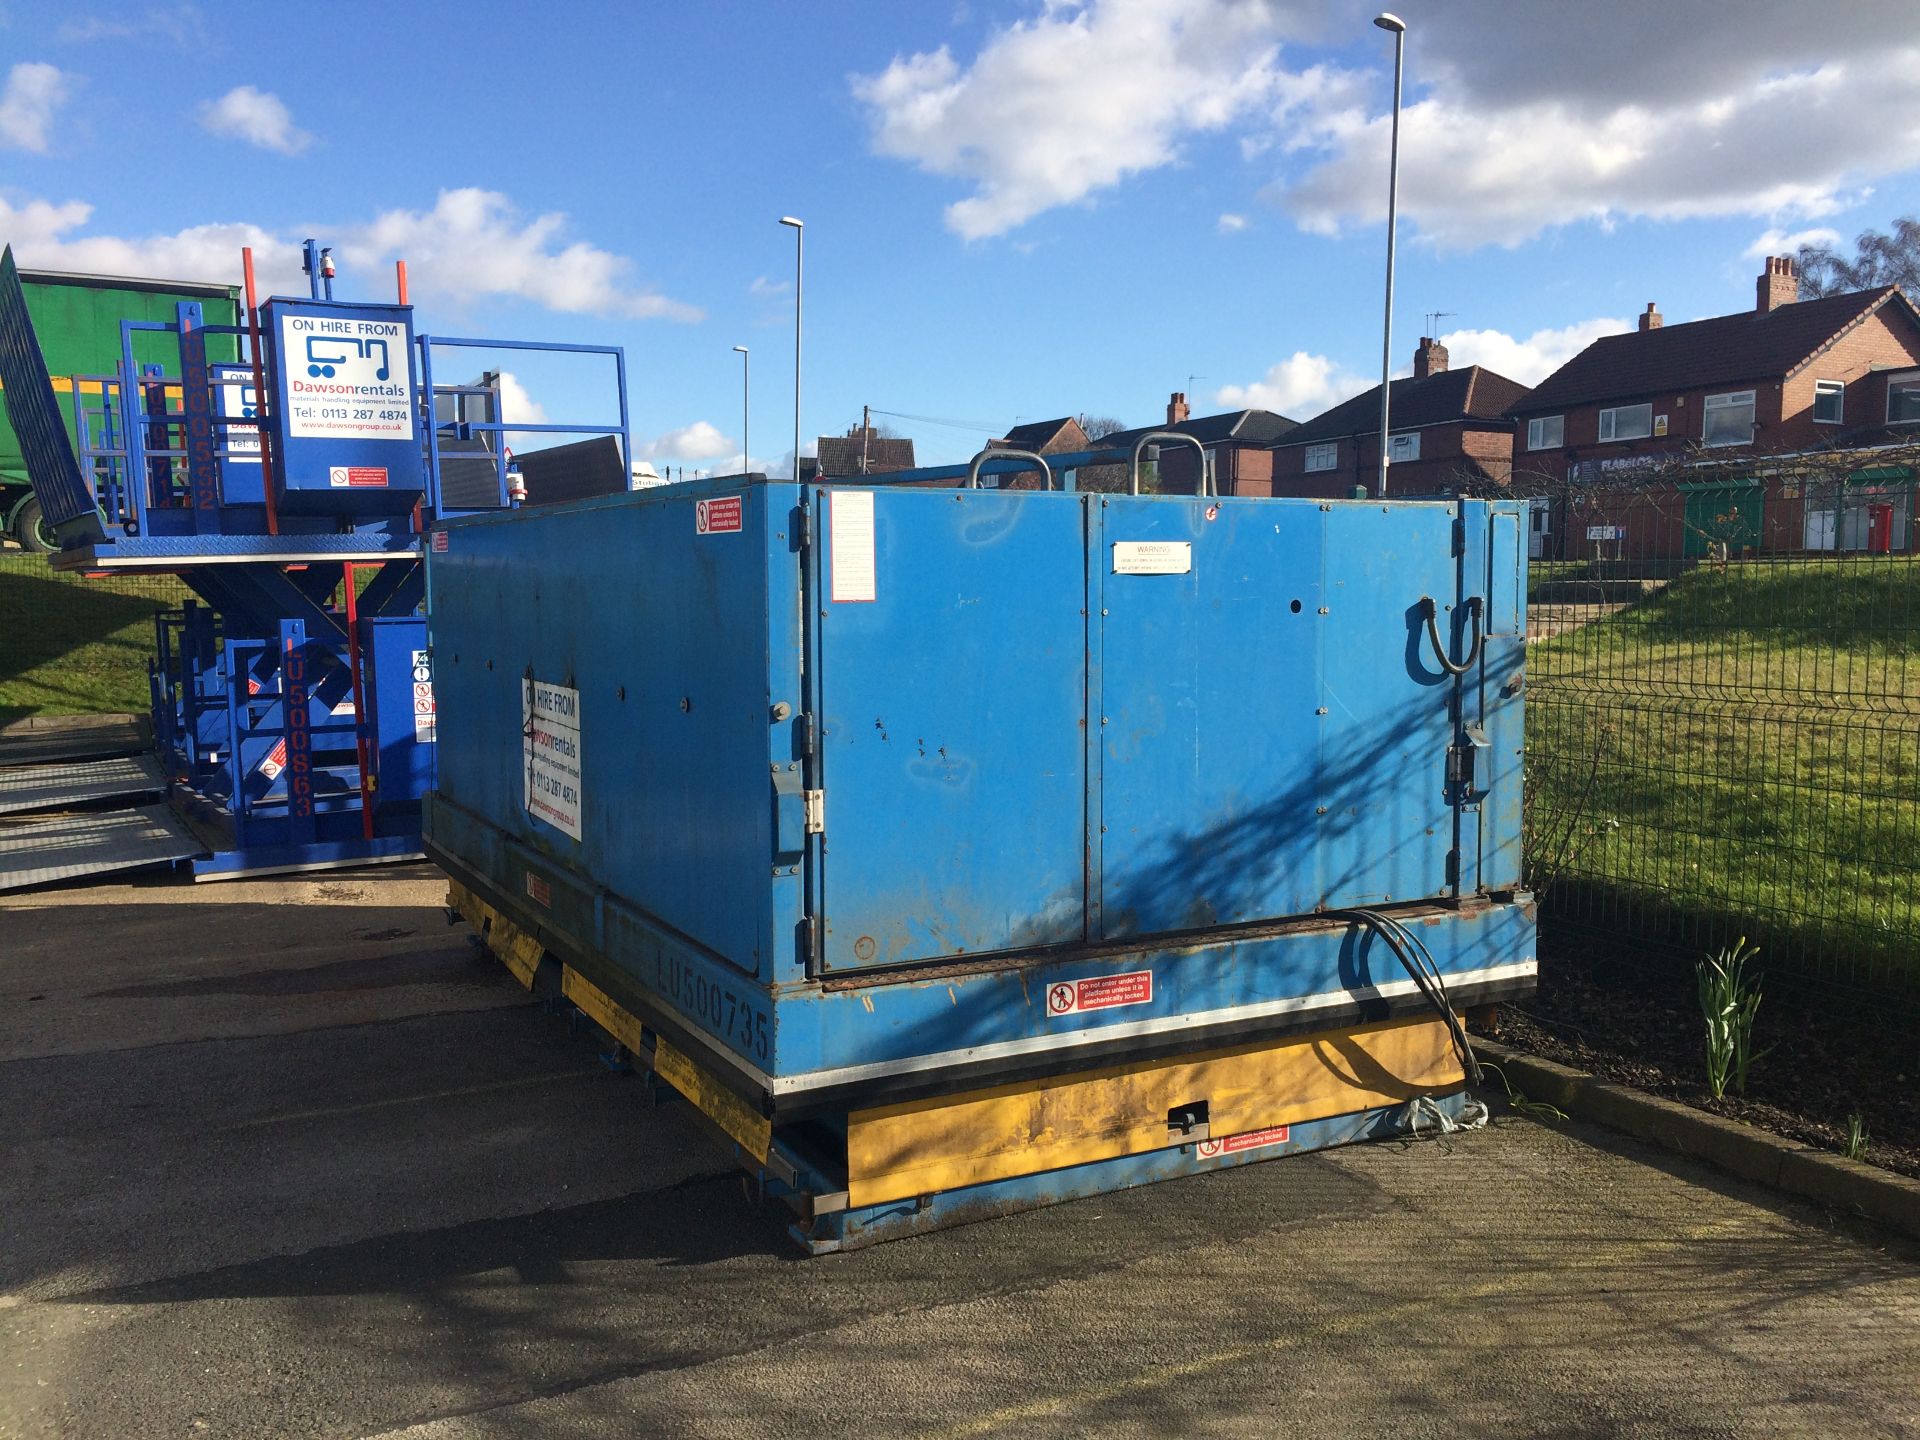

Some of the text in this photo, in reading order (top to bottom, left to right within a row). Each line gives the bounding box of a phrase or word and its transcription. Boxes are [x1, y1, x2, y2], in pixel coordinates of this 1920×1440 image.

[292, 319, 398, 336] ON HIRE FROM
[293, 380, 405, 397] Dawsonrentals
[322, 397, 350, 405] handling
[352, 398, 386, 407] equipment
[294, 407, 407, 421] Tel: 0113 287 4874
[301, 421, 402, 431] www.dawsongroup.co.uk
[537, 689, 553, 711] HIRE
[554, 693, 576, 718] FROM
[526, 720, 577, 759] wsonrentals
[537, 770, 550, 793] 0113
[551, 778, 562, 798] 287
[563, 785, 578, 808] 4874
[1080, 983, 1089, 991] Do
[1118, 977, 1136, 985] under
[1136, 975, 1148, 983] this
[1083, 991, 1145, 1006] mechanically locked
[1084, 988, 1110, 999] platform
[1111, 985, 1132, 994] unless
[657, 949, 768, 1061] LU500735
[1228, 1136, 1264, 1148] mechanically
[1264, 1132, 1282, 1141] locked
